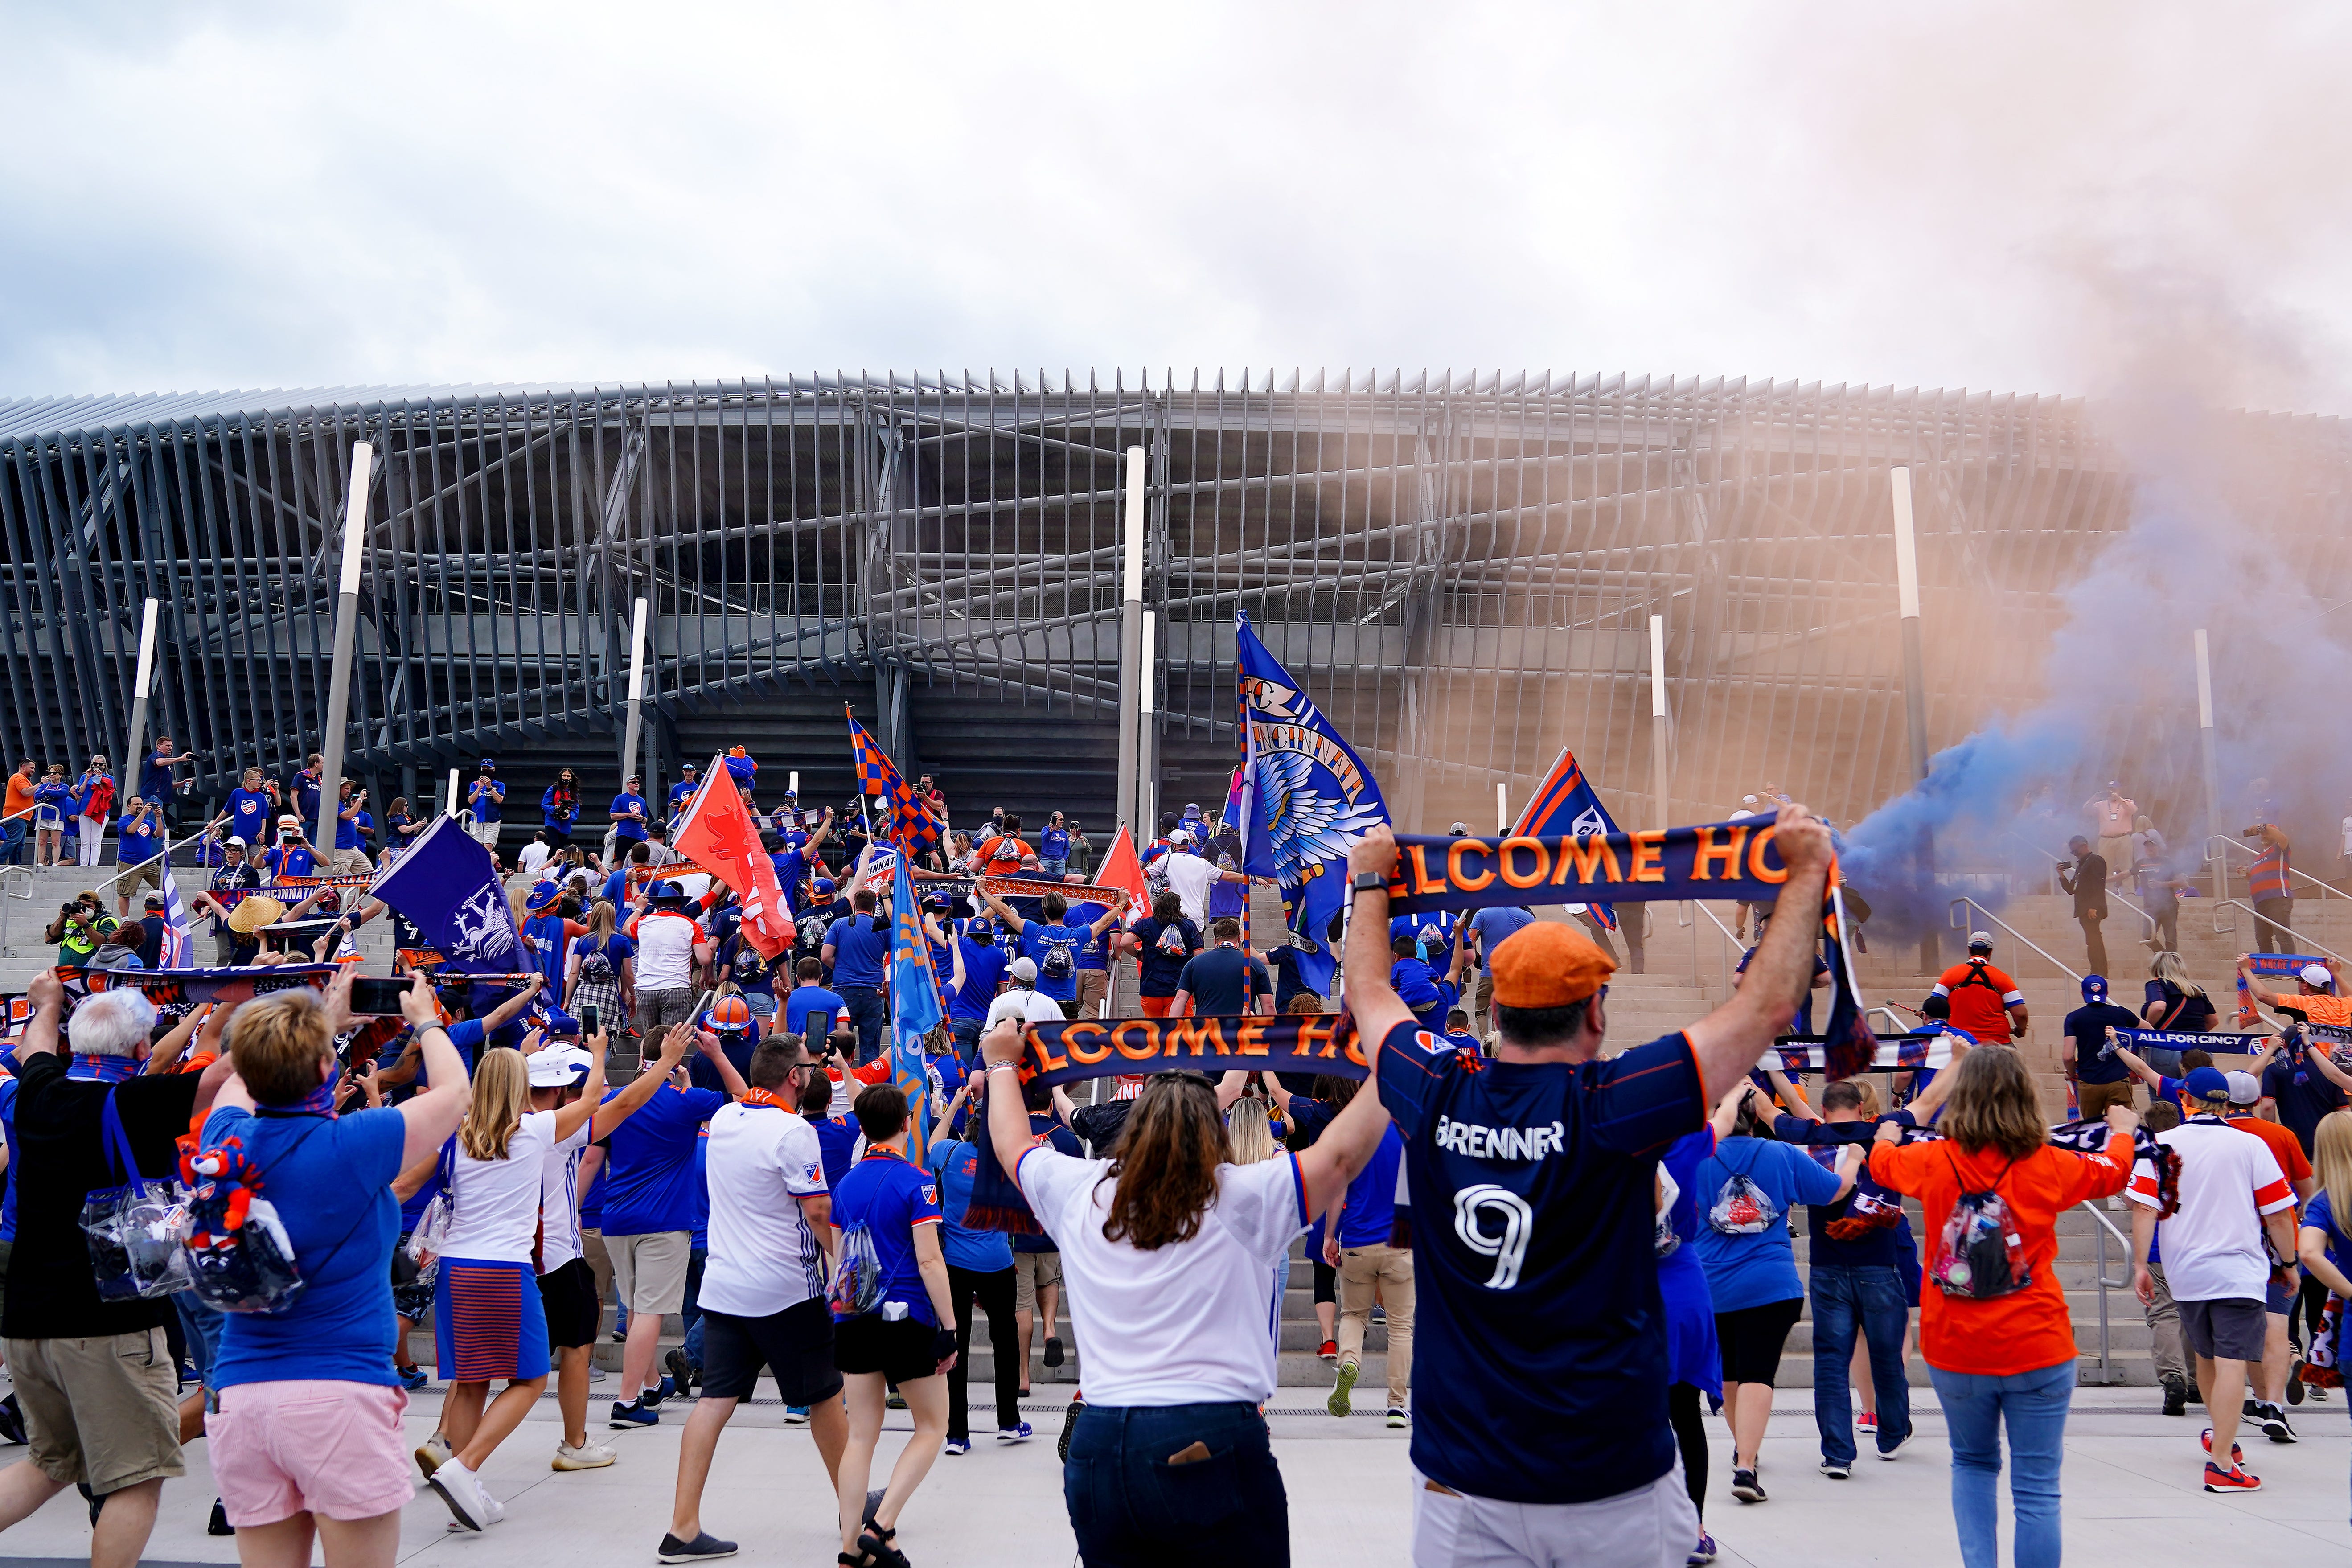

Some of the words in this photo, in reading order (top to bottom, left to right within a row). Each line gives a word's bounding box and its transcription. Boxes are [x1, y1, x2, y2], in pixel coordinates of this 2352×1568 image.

[1252, 725, 1363, 796] INCINNATI
[868, 856, 896, 875] INNAT
[1388, 829, 1667, 898] LCOME
[2259, 958, 2289, 969] WHERE
[1018, 1017, 1275, 1085] LCOME
[1457, 1047, 1470, 1056] SMA
[2137, 1032, 2167, 1042] ALL
[2166, 1034, 2197, 1043] FOR
[2197, 1035, 2243, 1045] CINCY
[1435, 1114, 1565, 1162] BRENNER
[1453, 1184, 1533, 1291] 9
